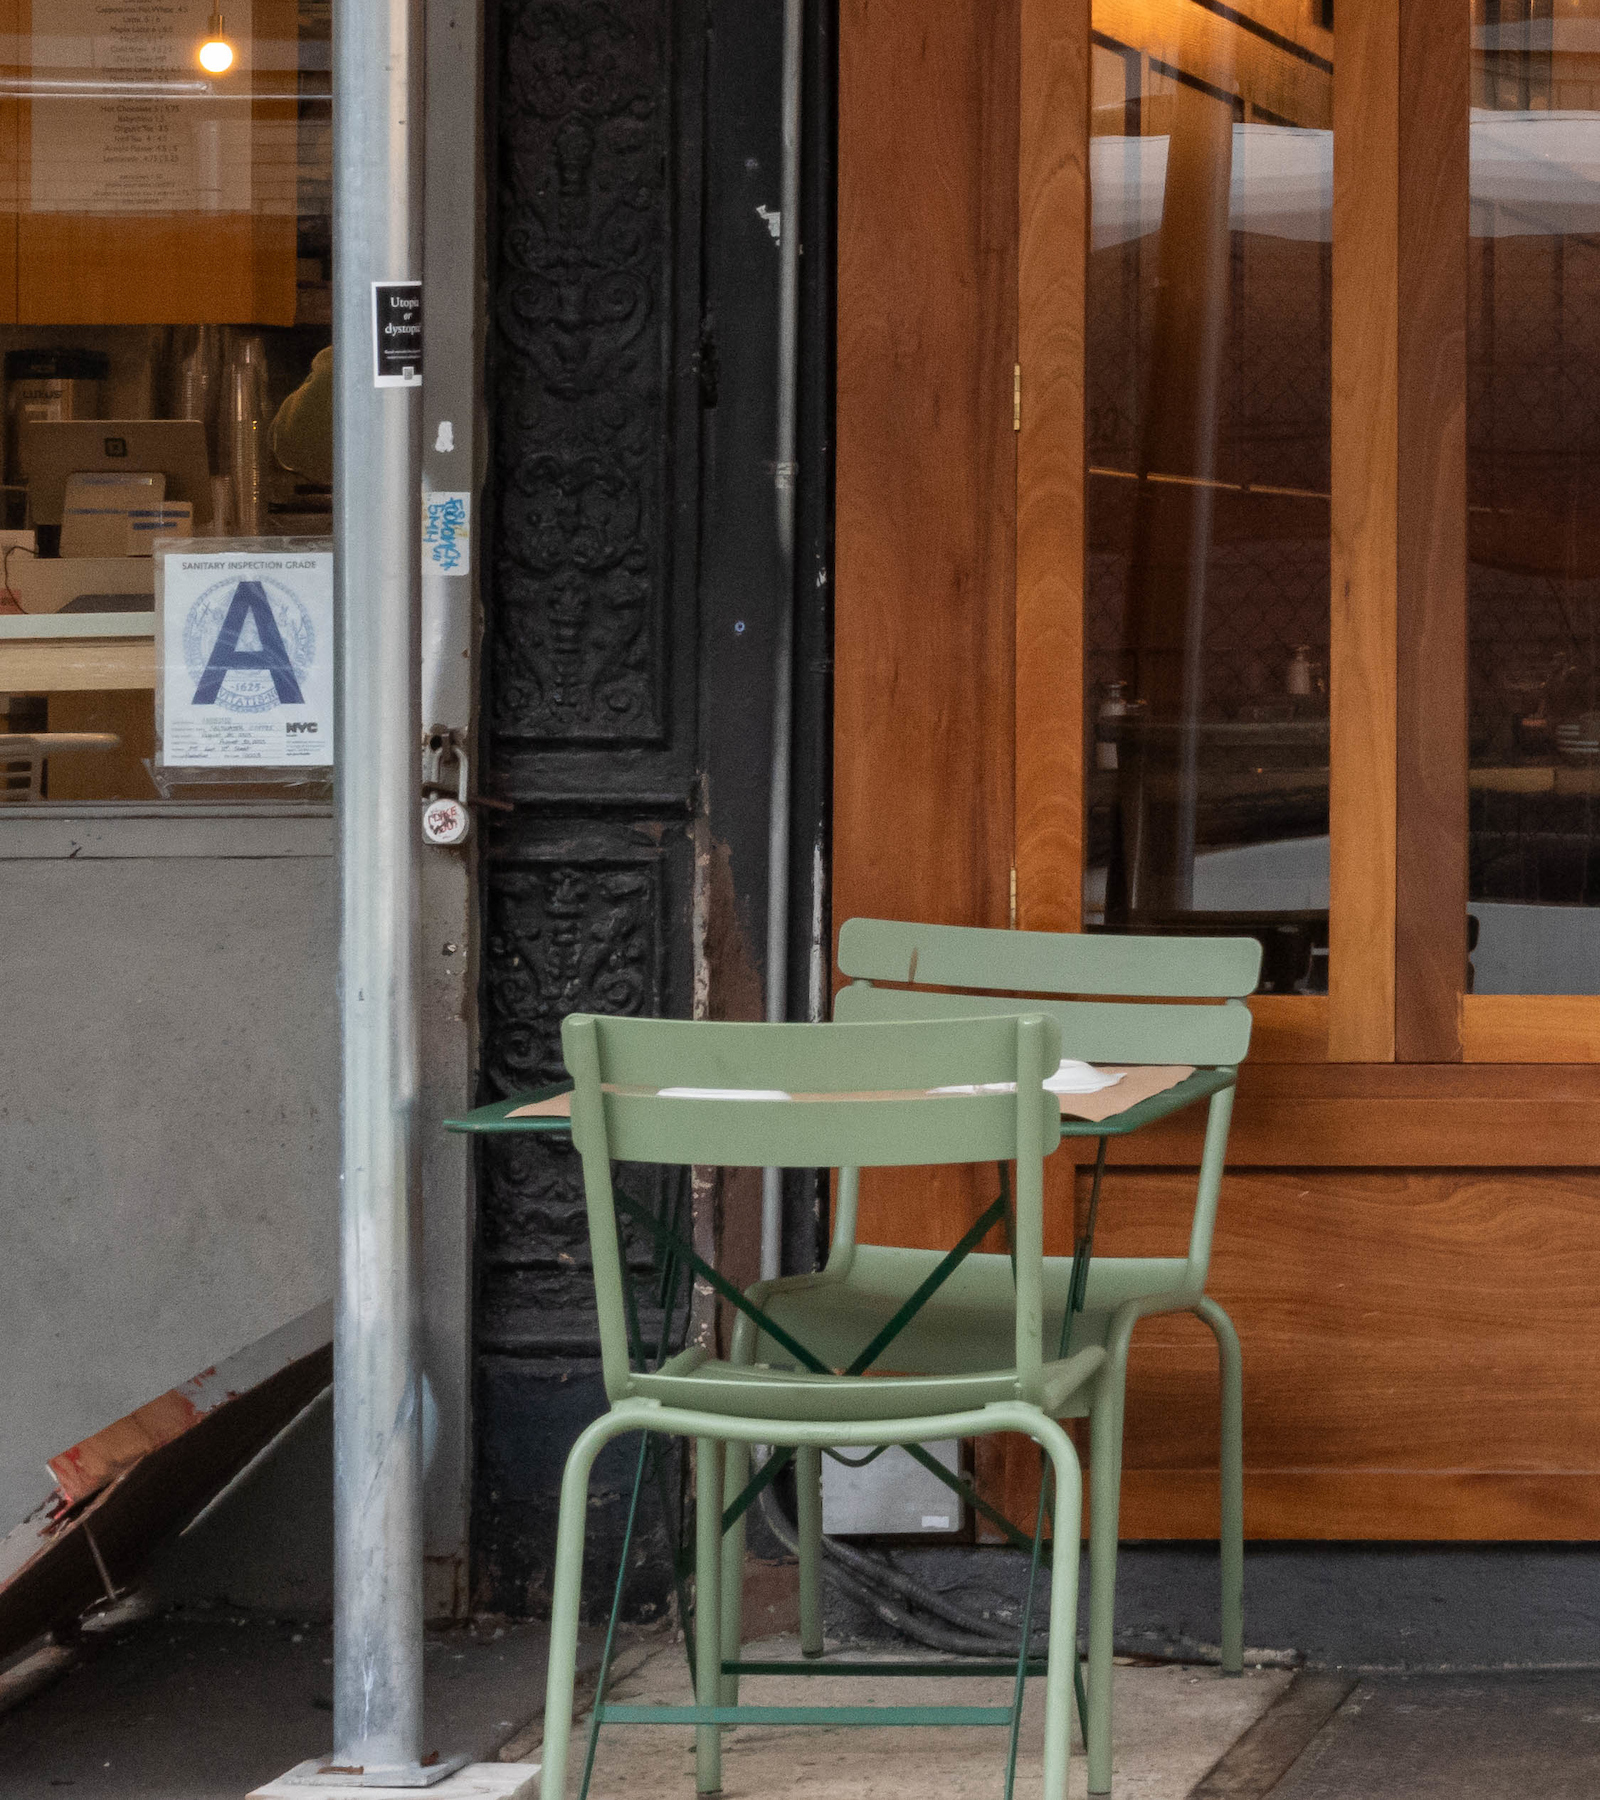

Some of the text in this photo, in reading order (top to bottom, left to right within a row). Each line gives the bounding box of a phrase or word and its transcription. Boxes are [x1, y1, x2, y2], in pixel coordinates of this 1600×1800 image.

[182, 561, 316, 570] SANITARY INSPECTION GRADE
[191, 581, 305, 705] A
[286, 722, 318, 734] NYC
